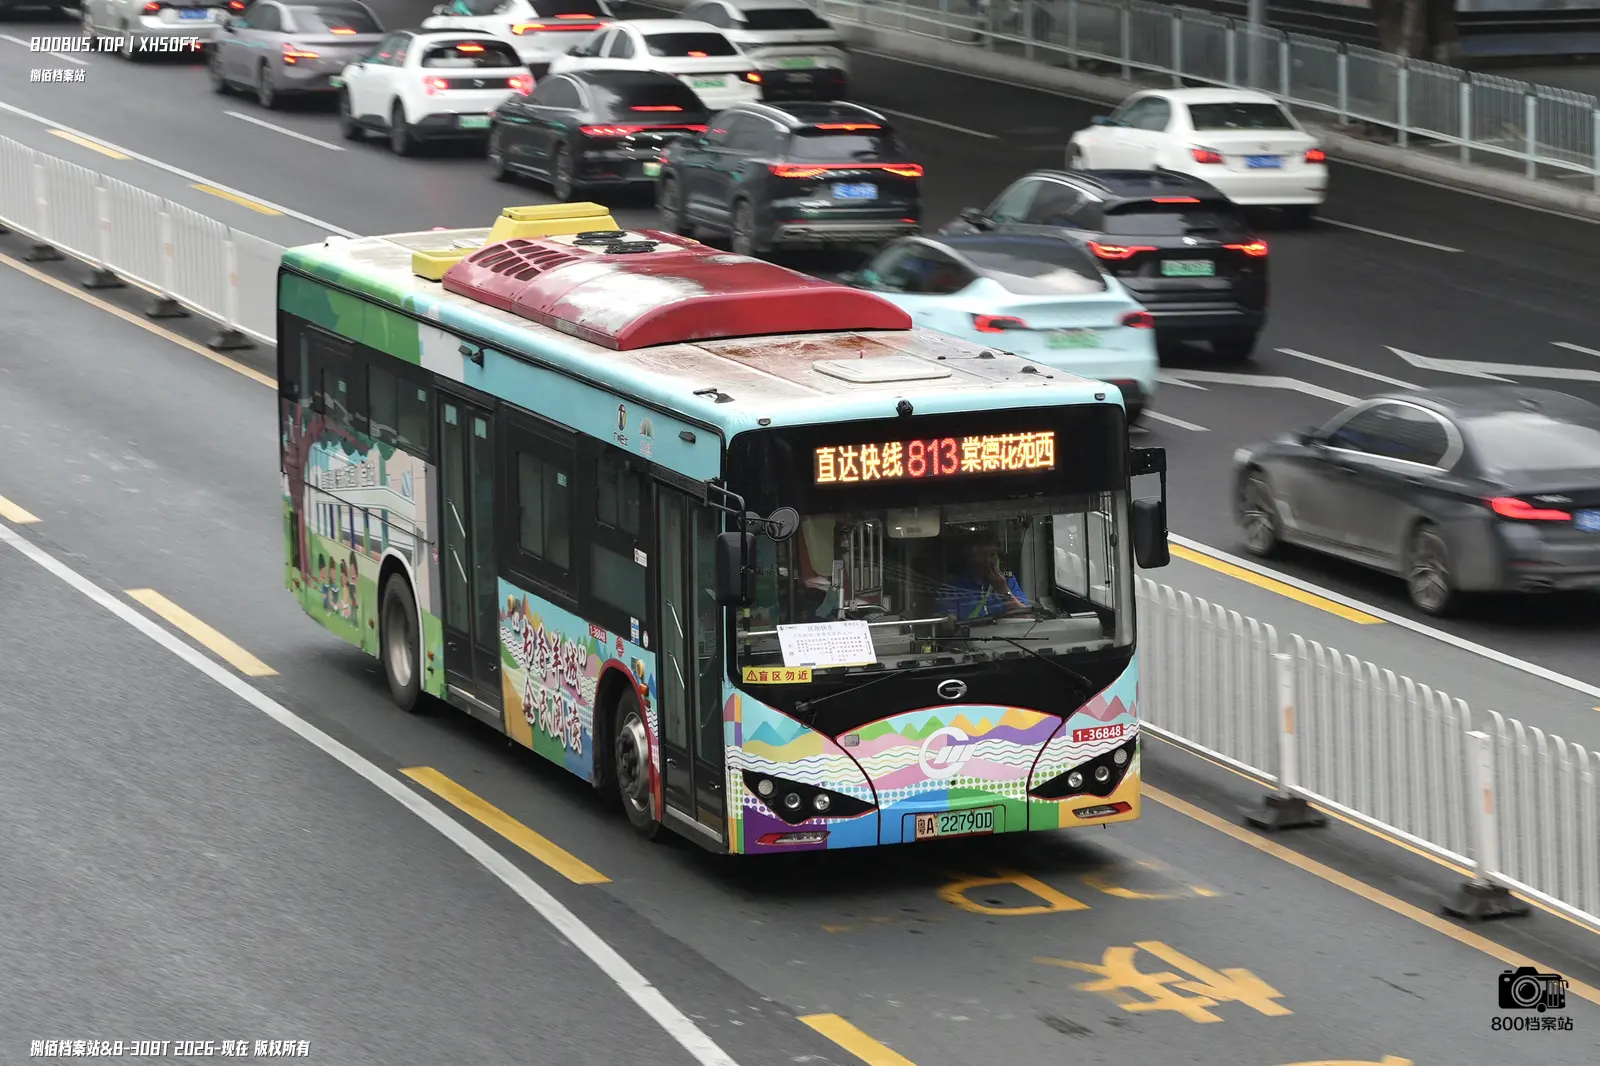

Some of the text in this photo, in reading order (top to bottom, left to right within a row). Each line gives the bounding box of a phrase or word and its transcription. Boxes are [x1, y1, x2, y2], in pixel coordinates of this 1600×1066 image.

[816, 431, 1055, 483] 直达快线 813 棠德花苑西
[759, 669, 808, 682] 盲区勿近
[1076, 725, 1121, 742] 1-36848
[940, 811, 993, 833] 22790D
